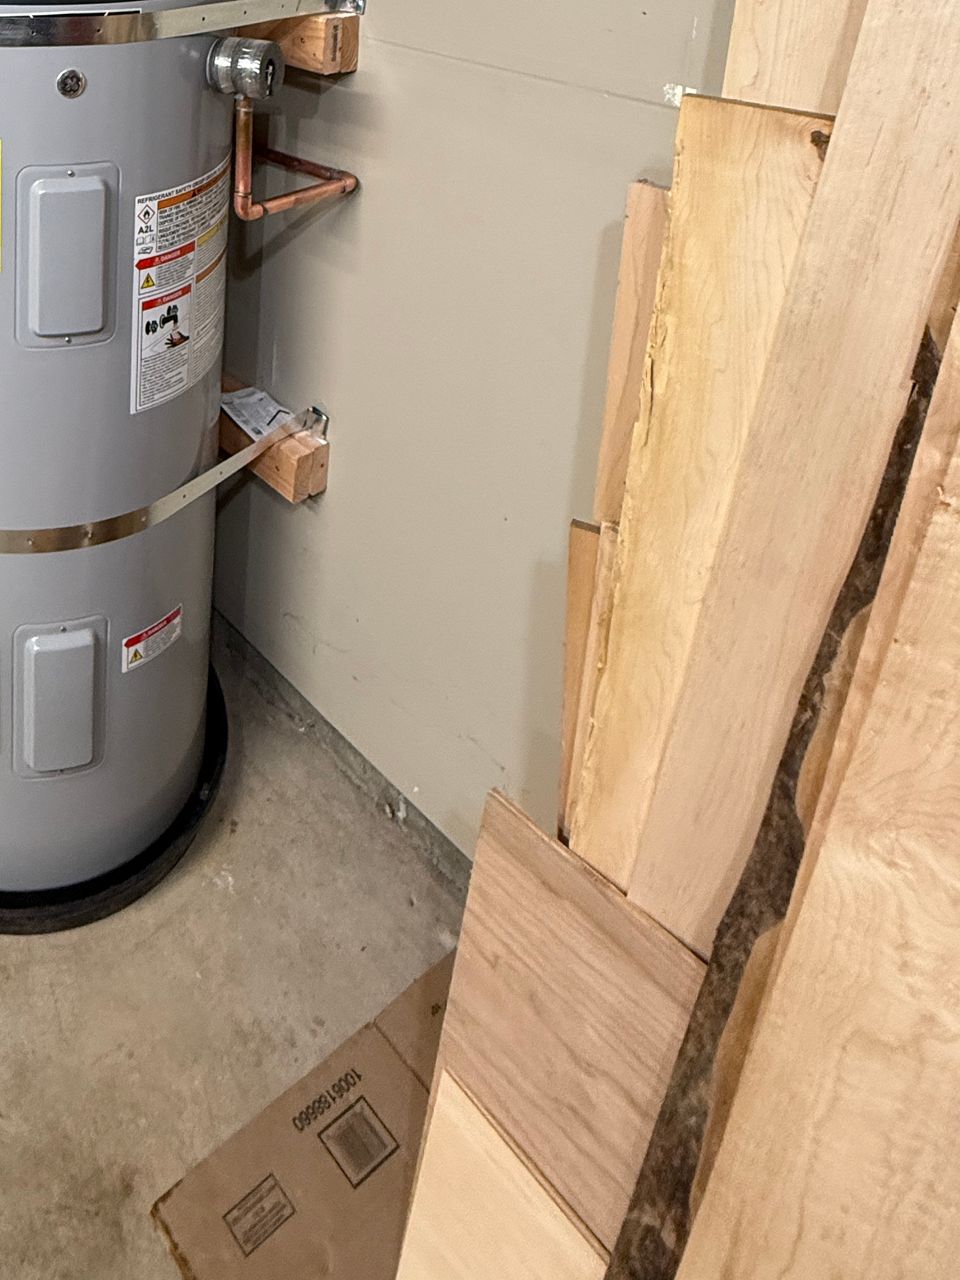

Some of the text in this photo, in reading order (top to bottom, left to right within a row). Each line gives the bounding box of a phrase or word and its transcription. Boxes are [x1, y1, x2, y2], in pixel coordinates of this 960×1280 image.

[137, 190, 175, 204] REFRIGERANT
[175, 184, 192, 195] SAFETY
[138, 225, 154, 235] A2L
